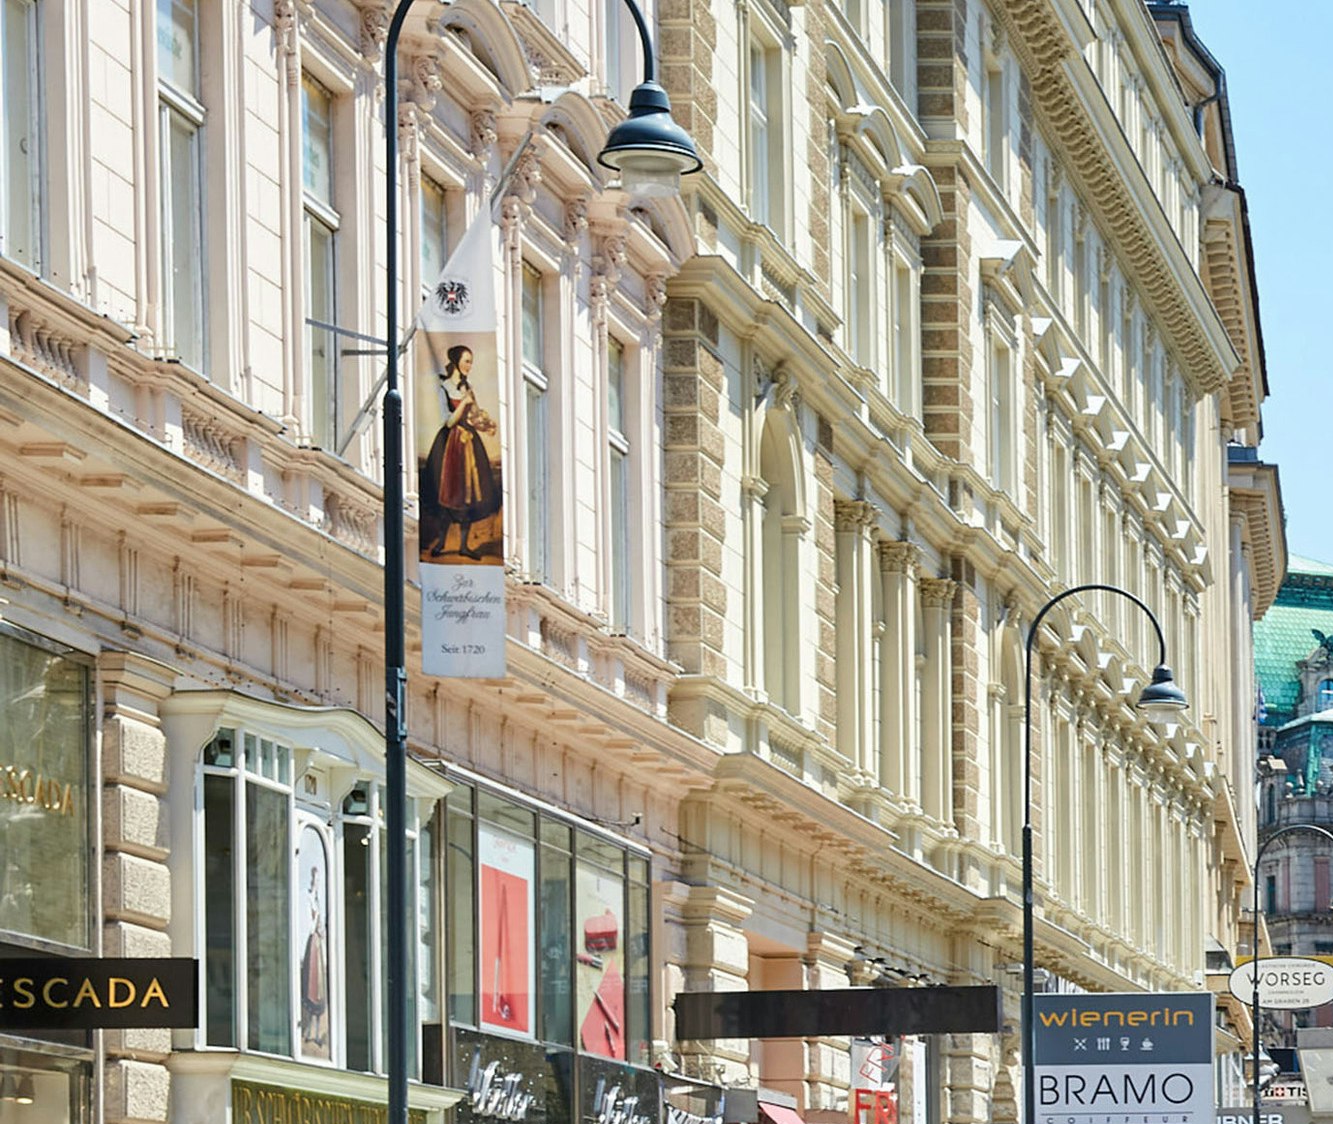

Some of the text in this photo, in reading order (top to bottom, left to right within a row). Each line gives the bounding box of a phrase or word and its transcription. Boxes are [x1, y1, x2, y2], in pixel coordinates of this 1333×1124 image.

[441, 643, 486, 655] Seit 1720
[0, 765, 76, 817] SCADA
[1246, 971, 1325, 986] WORSEG
[1039, 1008, 1194, 1027] wienerin
[1040, 1073, 1193, 1105] BRAMO
[1046, 1116, 1188, 1124] COIFFEUR
